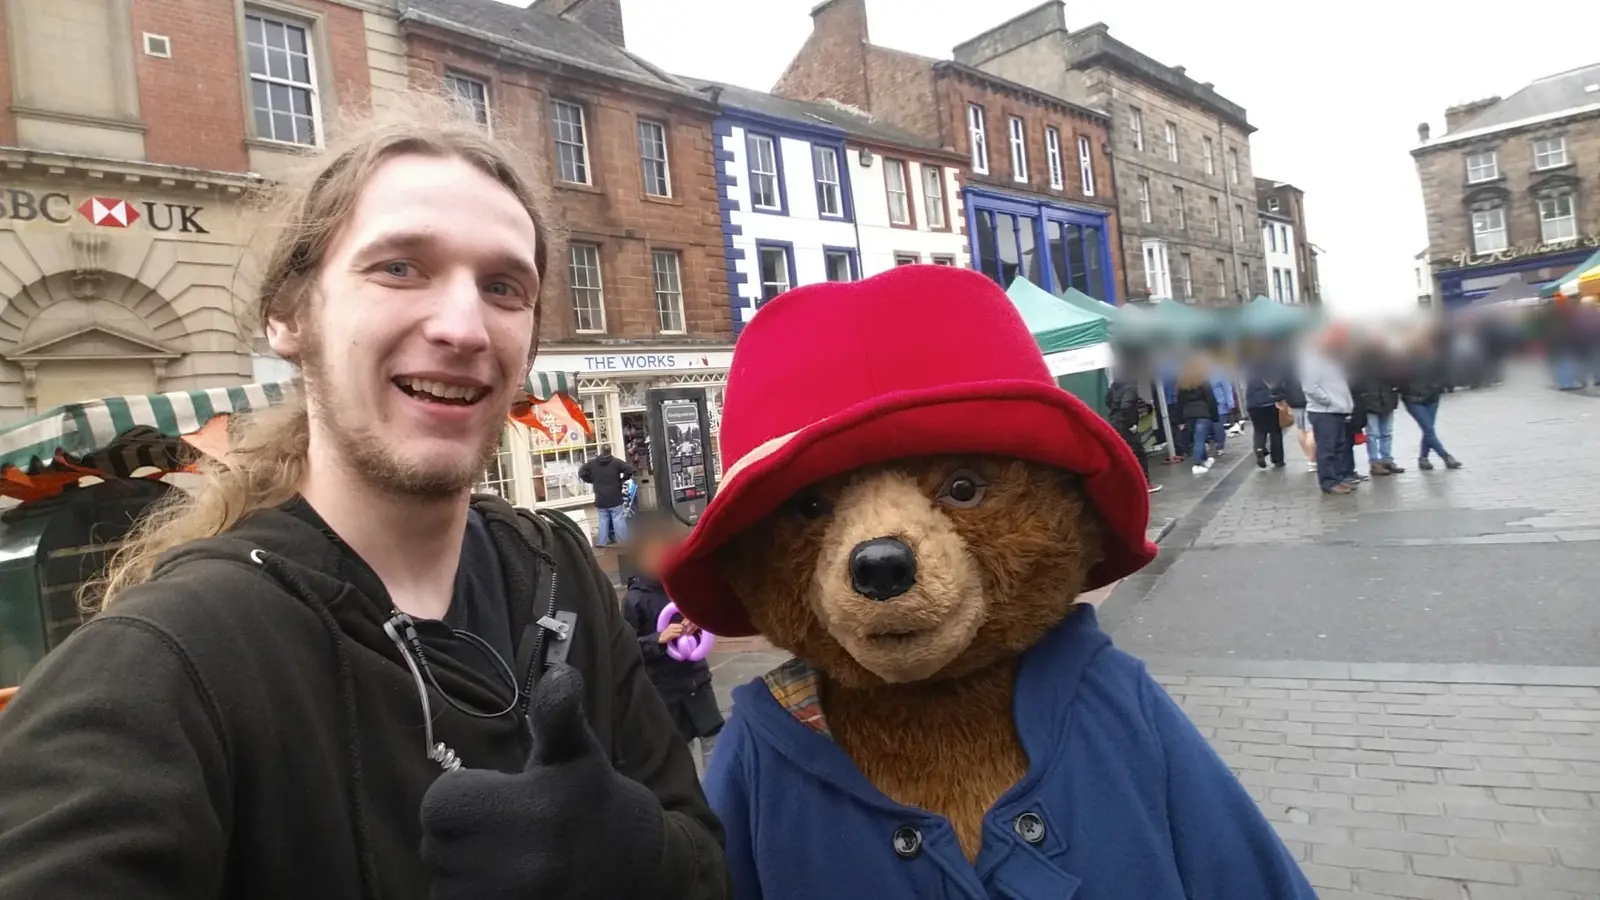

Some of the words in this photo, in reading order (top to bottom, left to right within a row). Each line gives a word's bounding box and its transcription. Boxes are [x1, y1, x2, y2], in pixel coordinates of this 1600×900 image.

[142, 202, 209, 234] UK
[584, 356, 616, 370] THE
[621, 355, 676, 369] WORKS
